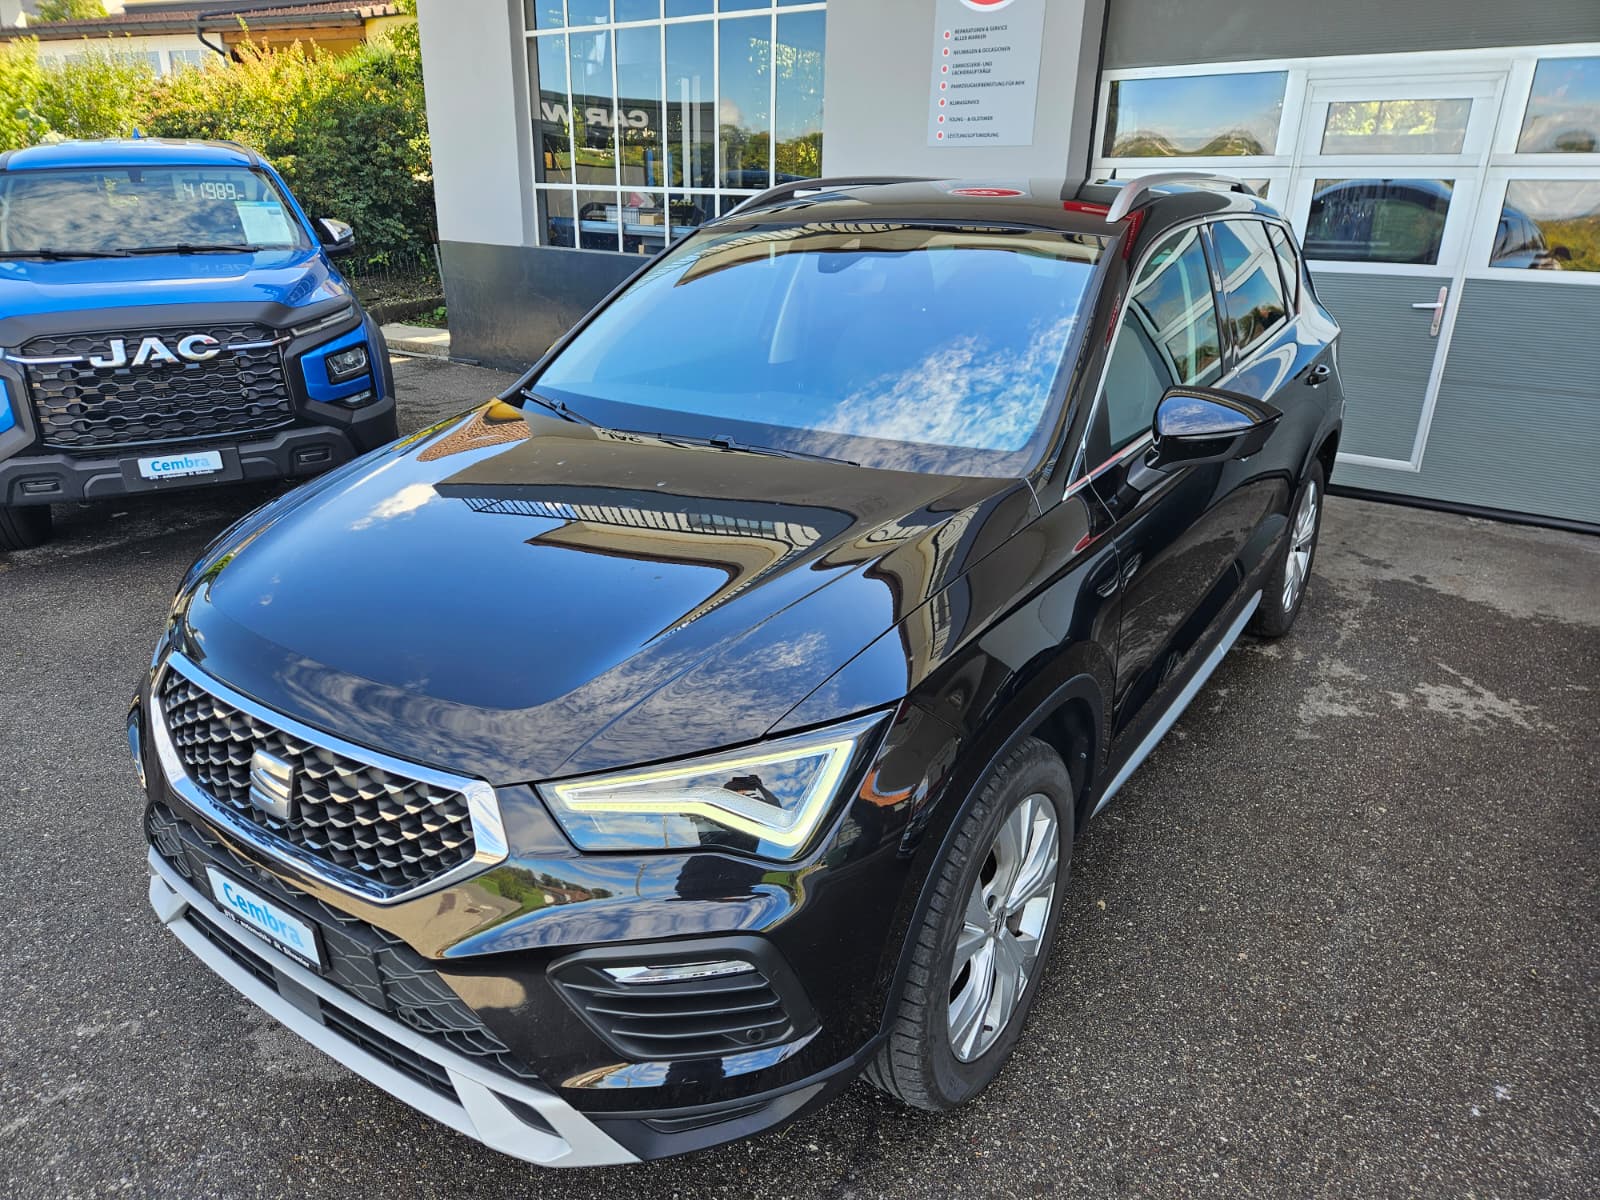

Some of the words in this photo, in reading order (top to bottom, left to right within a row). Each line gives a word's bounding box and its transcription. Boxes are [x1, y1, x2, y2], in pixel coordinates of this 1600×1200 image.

[89, 334, 220, 368] JAC
[151, 457, 209, 472] Cembra
[223, 882, 304, 948] Cembra
